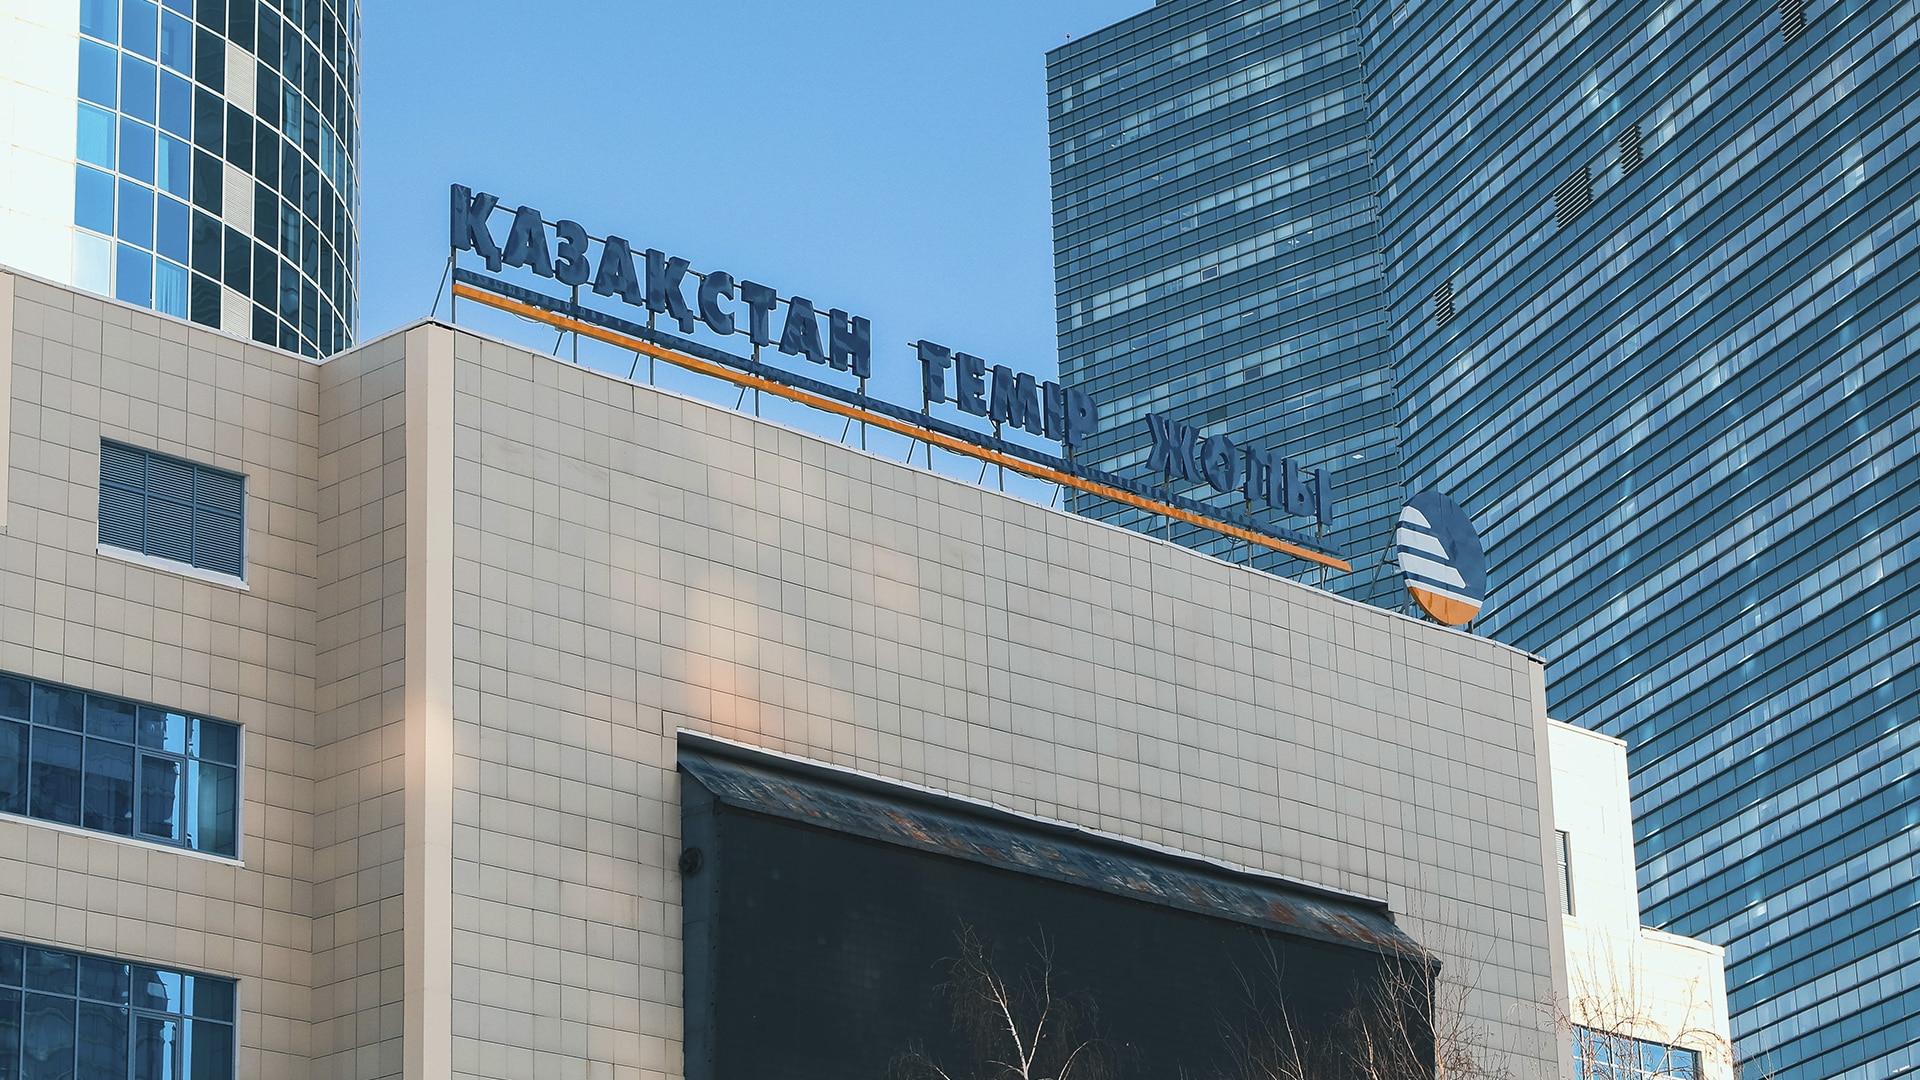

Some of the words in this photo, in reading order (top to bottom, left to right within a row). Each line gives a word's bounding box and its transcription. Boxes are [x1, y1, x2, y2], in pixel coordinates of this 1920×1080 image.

[451, 183, 871, 378] ҚАЗАҚСТАН
[918, 340, 1098, 448] ТЕМІР
[1145, 413, 1332, 526] ЖОЛЫ
